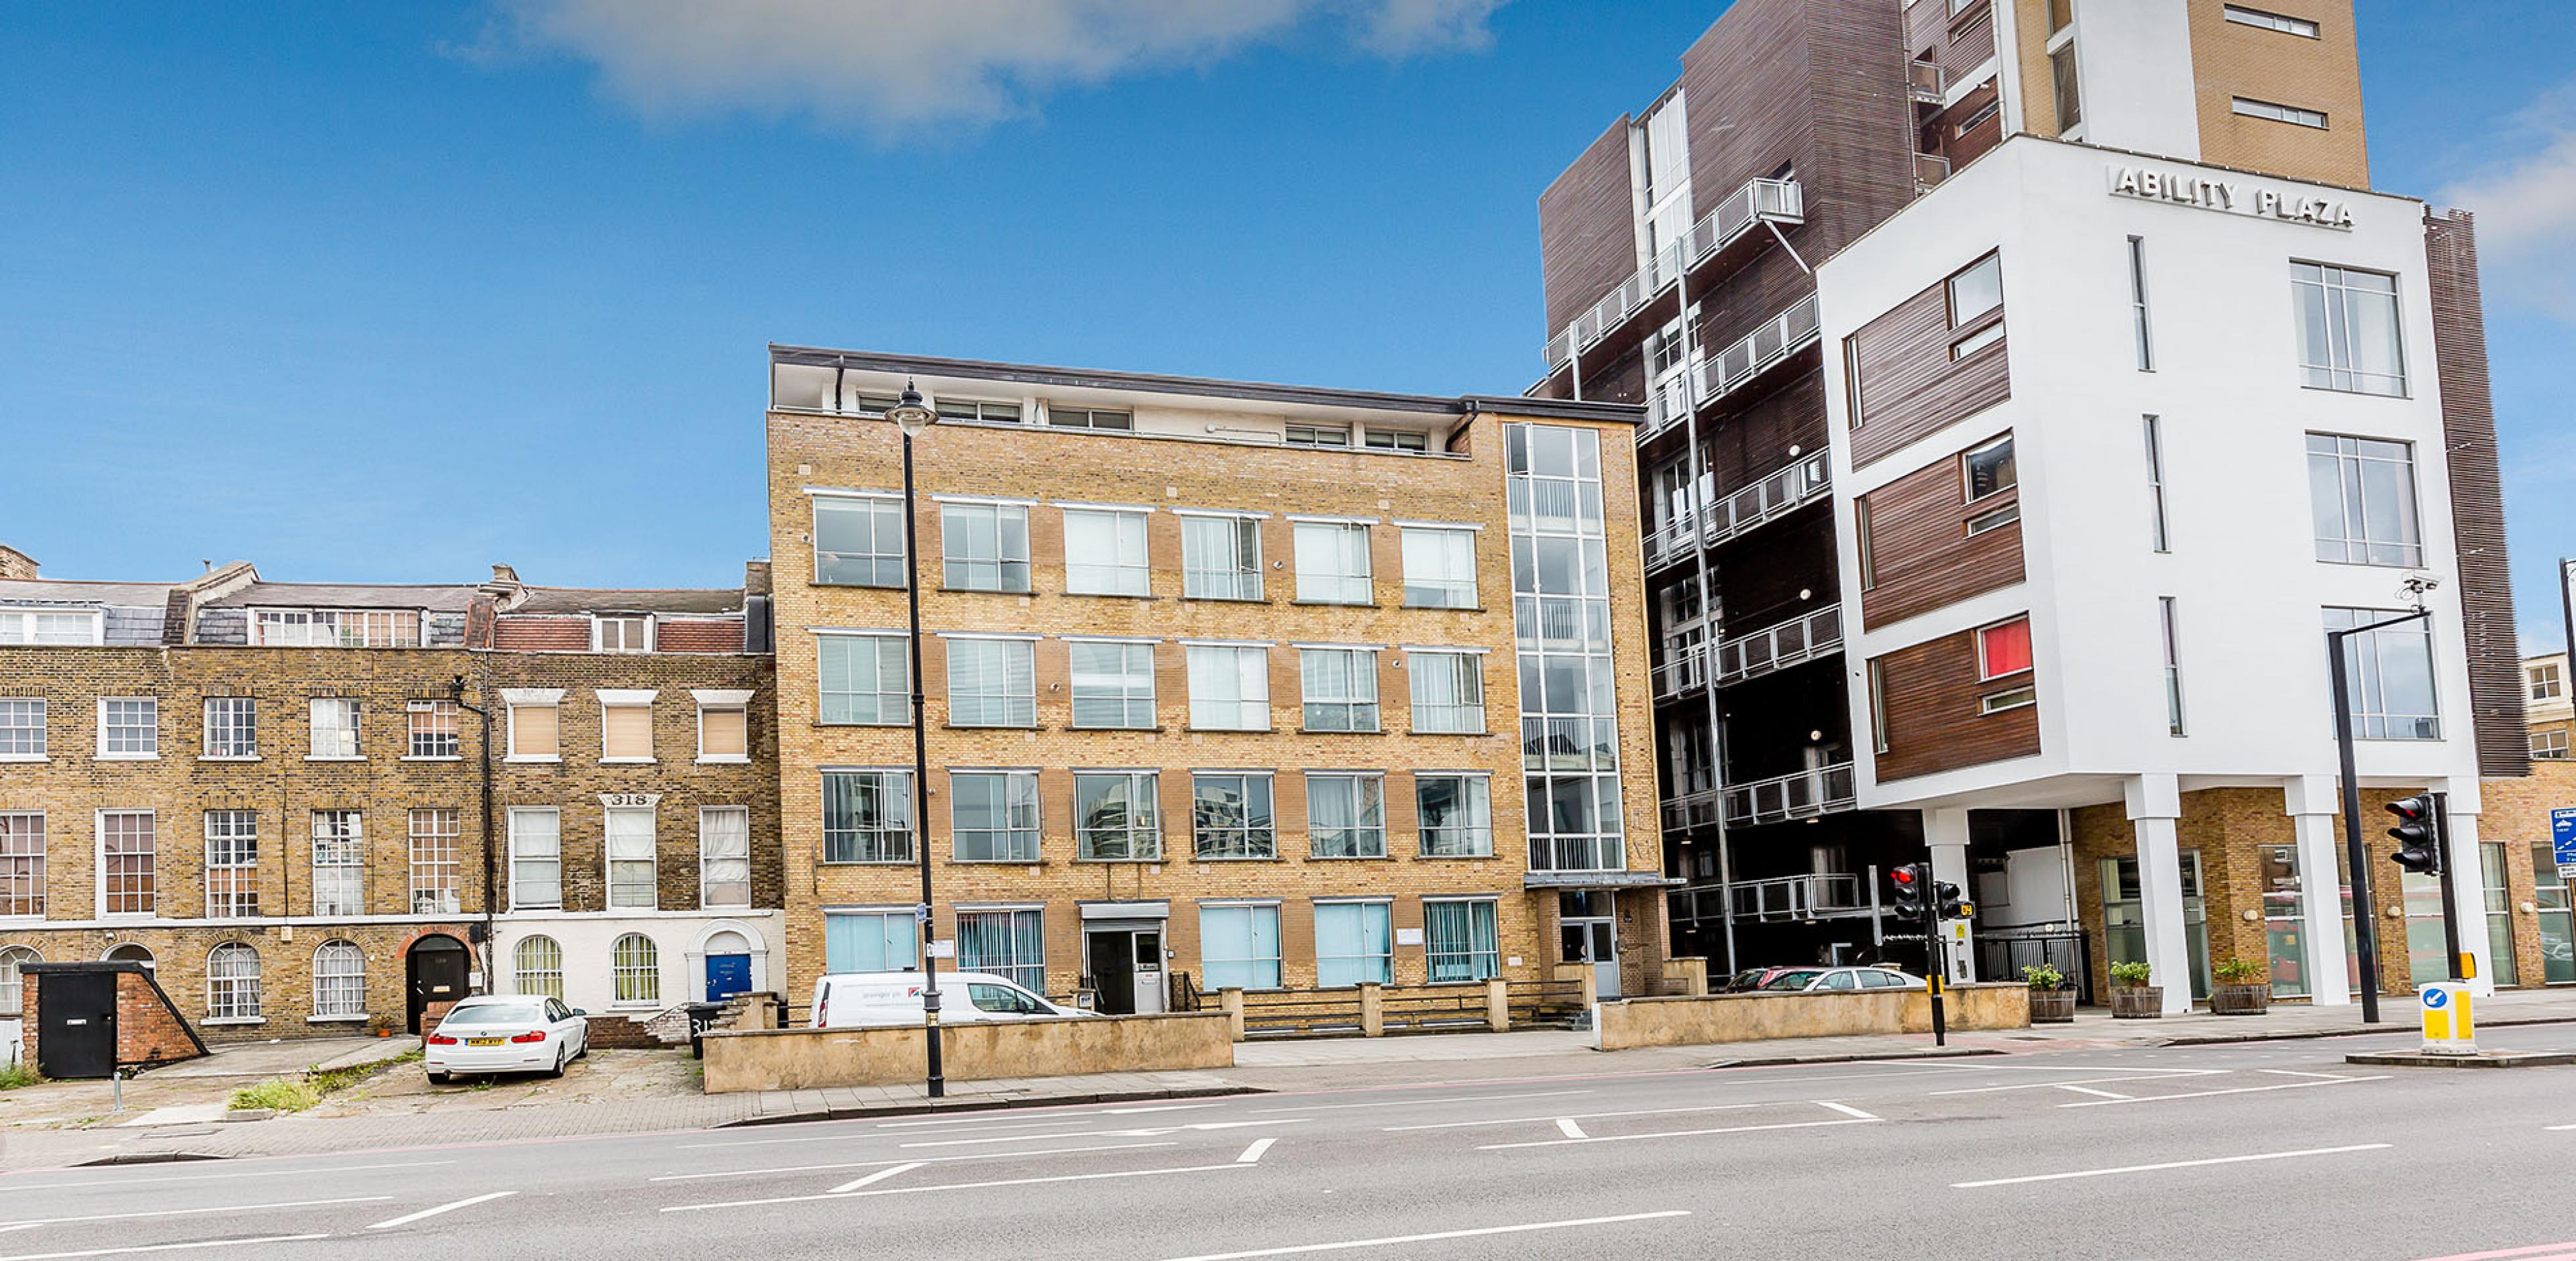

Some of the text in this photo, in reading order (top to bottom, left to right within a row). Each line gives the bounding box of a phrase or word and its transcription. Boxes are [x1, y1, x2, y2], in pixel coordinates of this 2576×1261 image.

[2115, 167, 2355, 227] ABILITY PLAZA
[611, 794, 647, 806] 318
